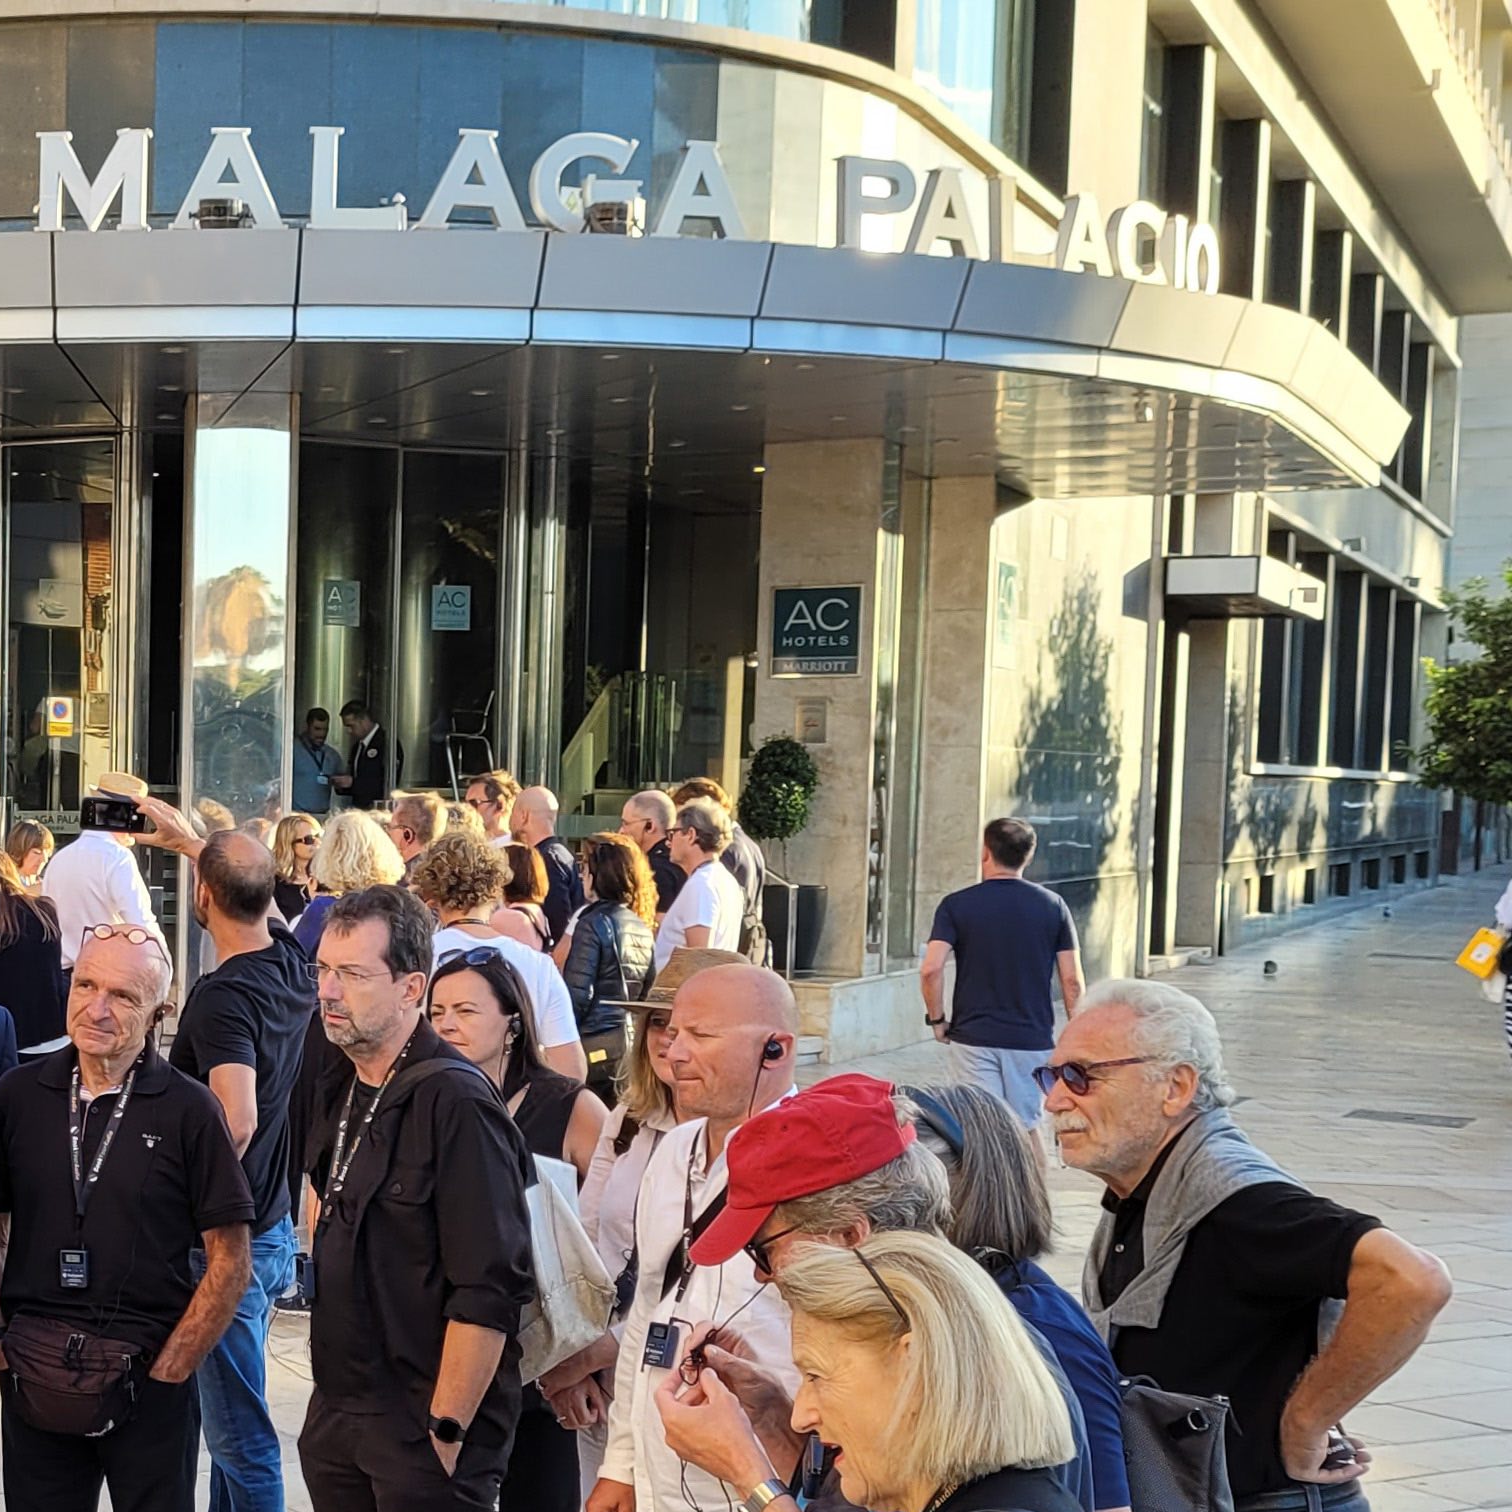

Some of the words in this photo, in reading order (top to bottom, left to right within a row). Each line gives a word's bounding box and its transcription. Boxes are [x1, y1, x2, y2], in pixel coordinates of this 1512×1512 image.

[35, 126, 752, 242] MALAGA
[834, 155, 1222, 296] PALACIO
[438, 591, 466, 608] AC
[783, 598, 850, 632] AC
[782, 635, 850, 647] HOTELS
[782, 660, 849, 672] MARRIOTT
